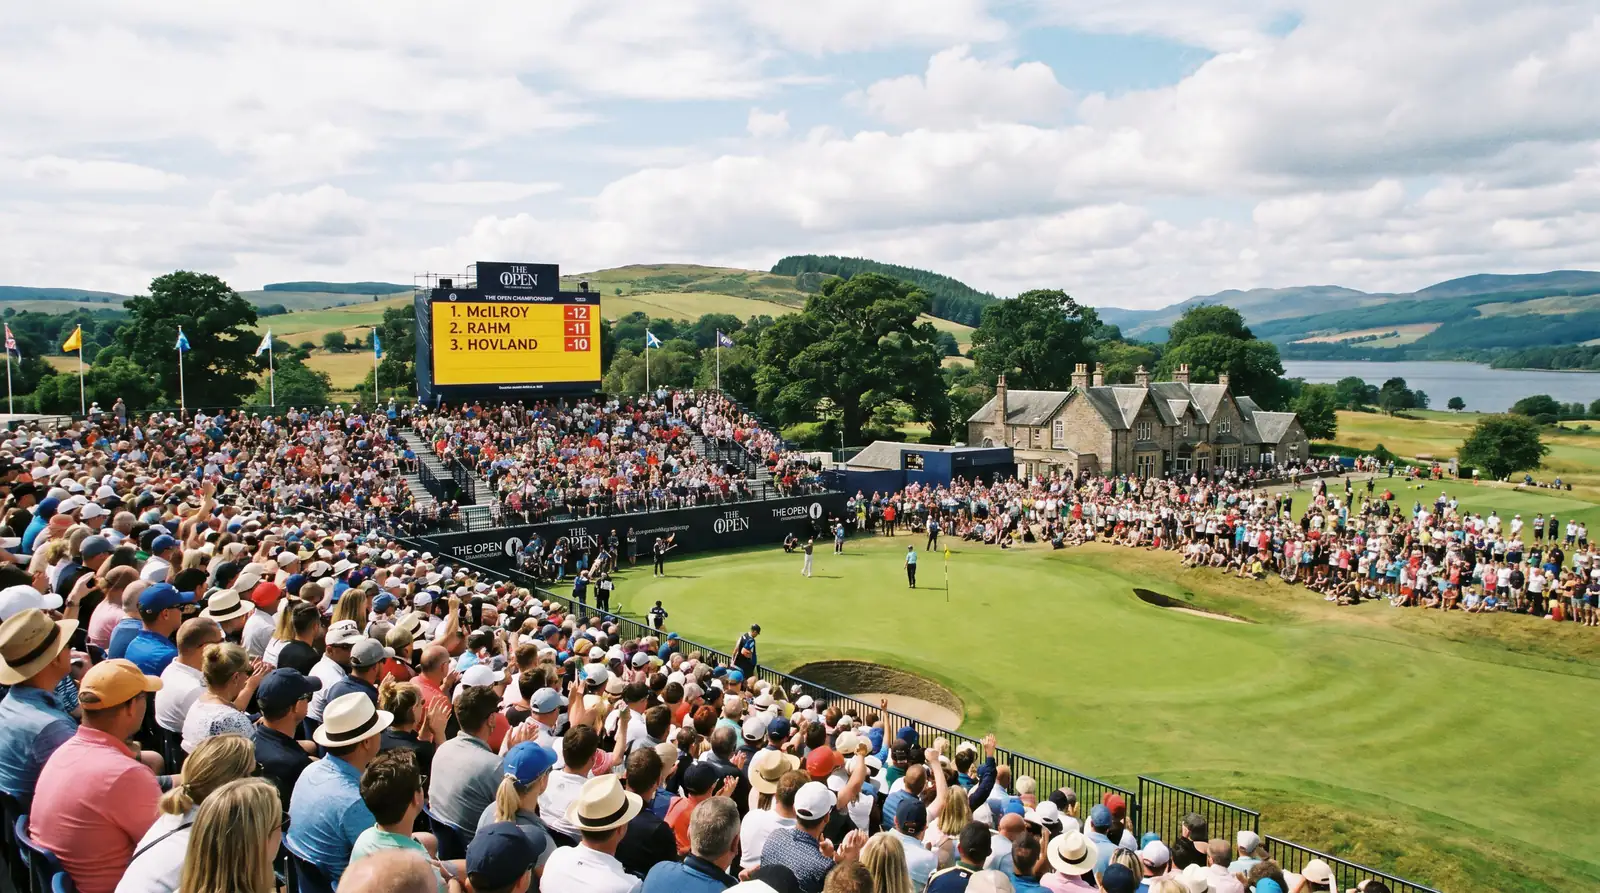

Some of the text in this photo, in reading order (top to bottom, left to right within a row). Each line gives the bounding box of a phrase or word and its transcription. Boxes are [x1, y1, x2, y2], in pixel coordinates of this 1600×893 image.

[511, 265, 528, 274] THE
[500, 271, 538, 286] OPEN
[451, 305, 587, 319] 1. McILROY -12
[450, 322, 586, 335] 2. RAHM -11
[450, 338, 588, 351] 3. HOVLAND -10
[724, 510, 740, 519] THE
[771, 505, 808, 517] THE OPEN
[568, 526, 587, 537] THE
[713, 517, 749, 534] OPEN
[452, 541, 503, 556] THE OPEN
